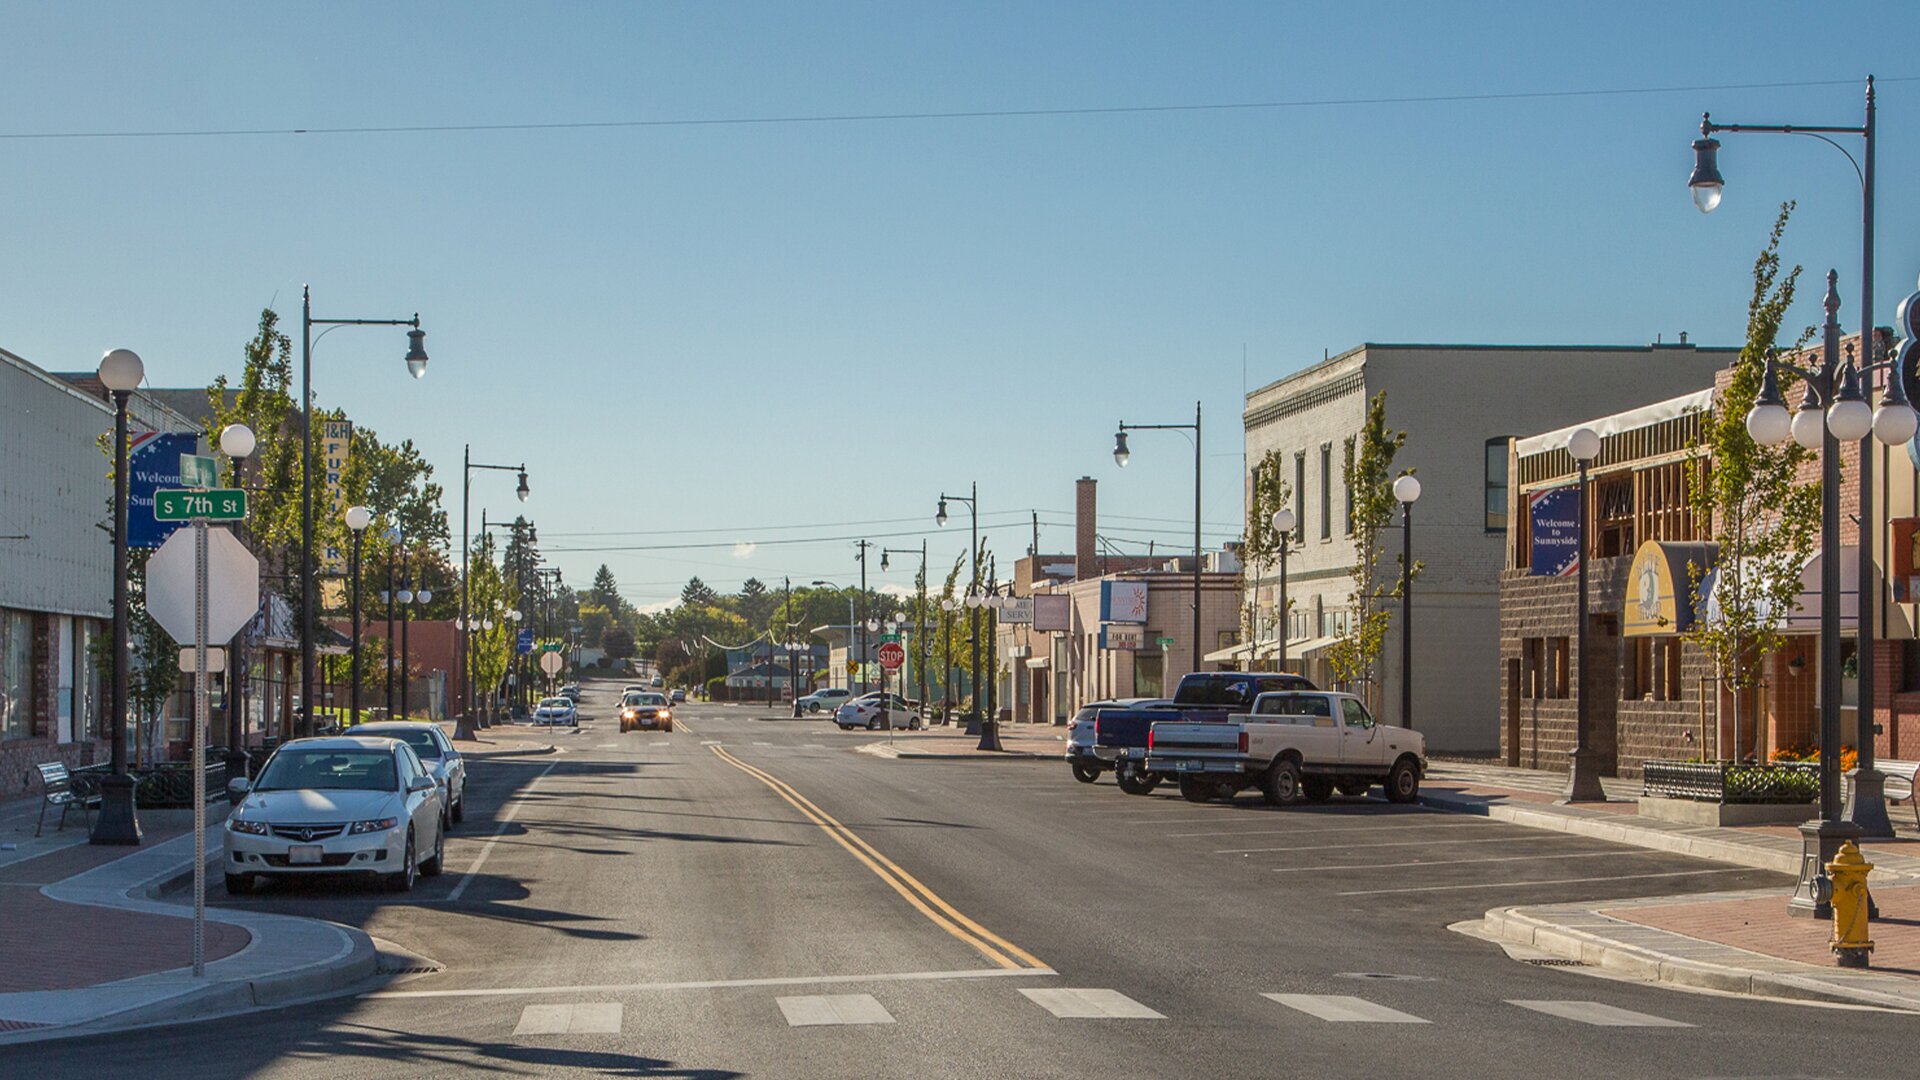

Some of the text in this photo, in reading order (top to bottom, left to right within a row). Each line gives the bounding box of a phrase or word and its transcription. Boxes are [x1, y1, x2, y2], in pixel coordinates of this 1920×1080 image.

[136, 471, 181, 484] Welcom
[164, 500, 174, 514] S
[182, 496, 213, 514] 7th
[222, 499, 238, 514] St
[1536, 519, 1576, 528] Welcome
[1534, 536, 1578, 547] Sunnyside
[1007, 610, 1032, 619] SERV
[880, 651, 904, 661] STOP
